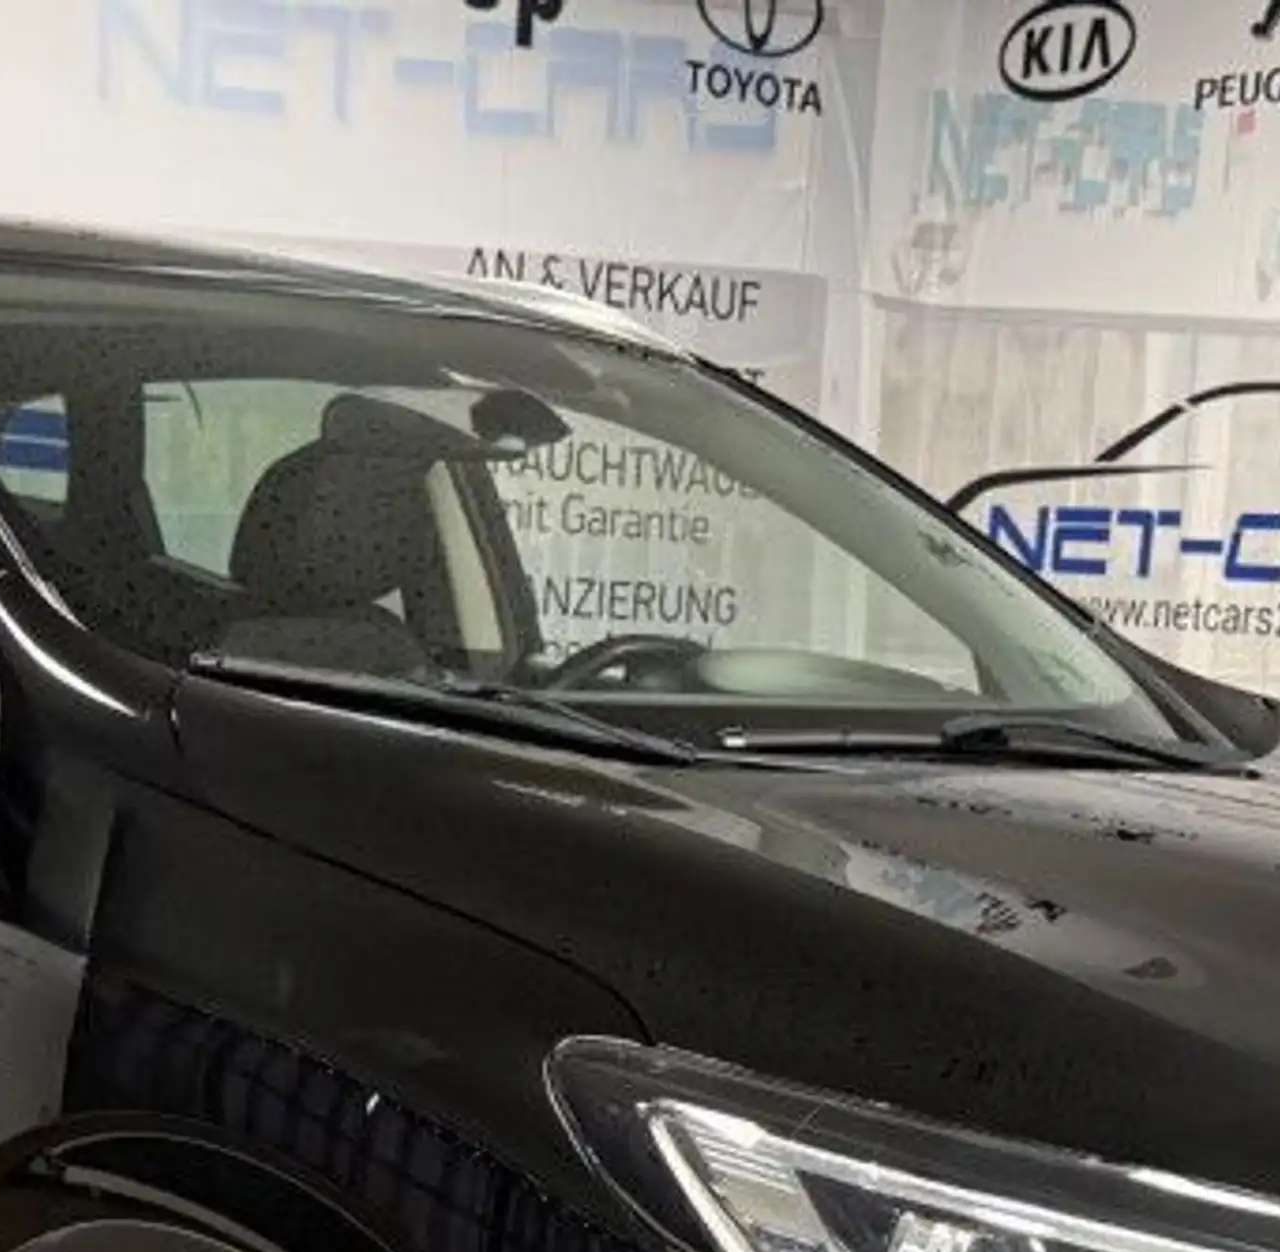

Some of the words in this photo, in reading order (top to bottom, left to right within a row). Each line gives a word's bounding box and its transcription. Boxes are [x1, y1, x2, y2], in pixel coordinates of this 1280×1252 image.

[1022, 17, 1112, 80] KIA
[685, 58, 823, 116] TOYOTA
[466, 247, 526, 282] AN
[541, 254, 564, 291] &
[578, 257, 762, 323] VERKAUF
[493, 442, 767, 500] AUCHTWAG
[560, 494, 711, 545] Garantie
